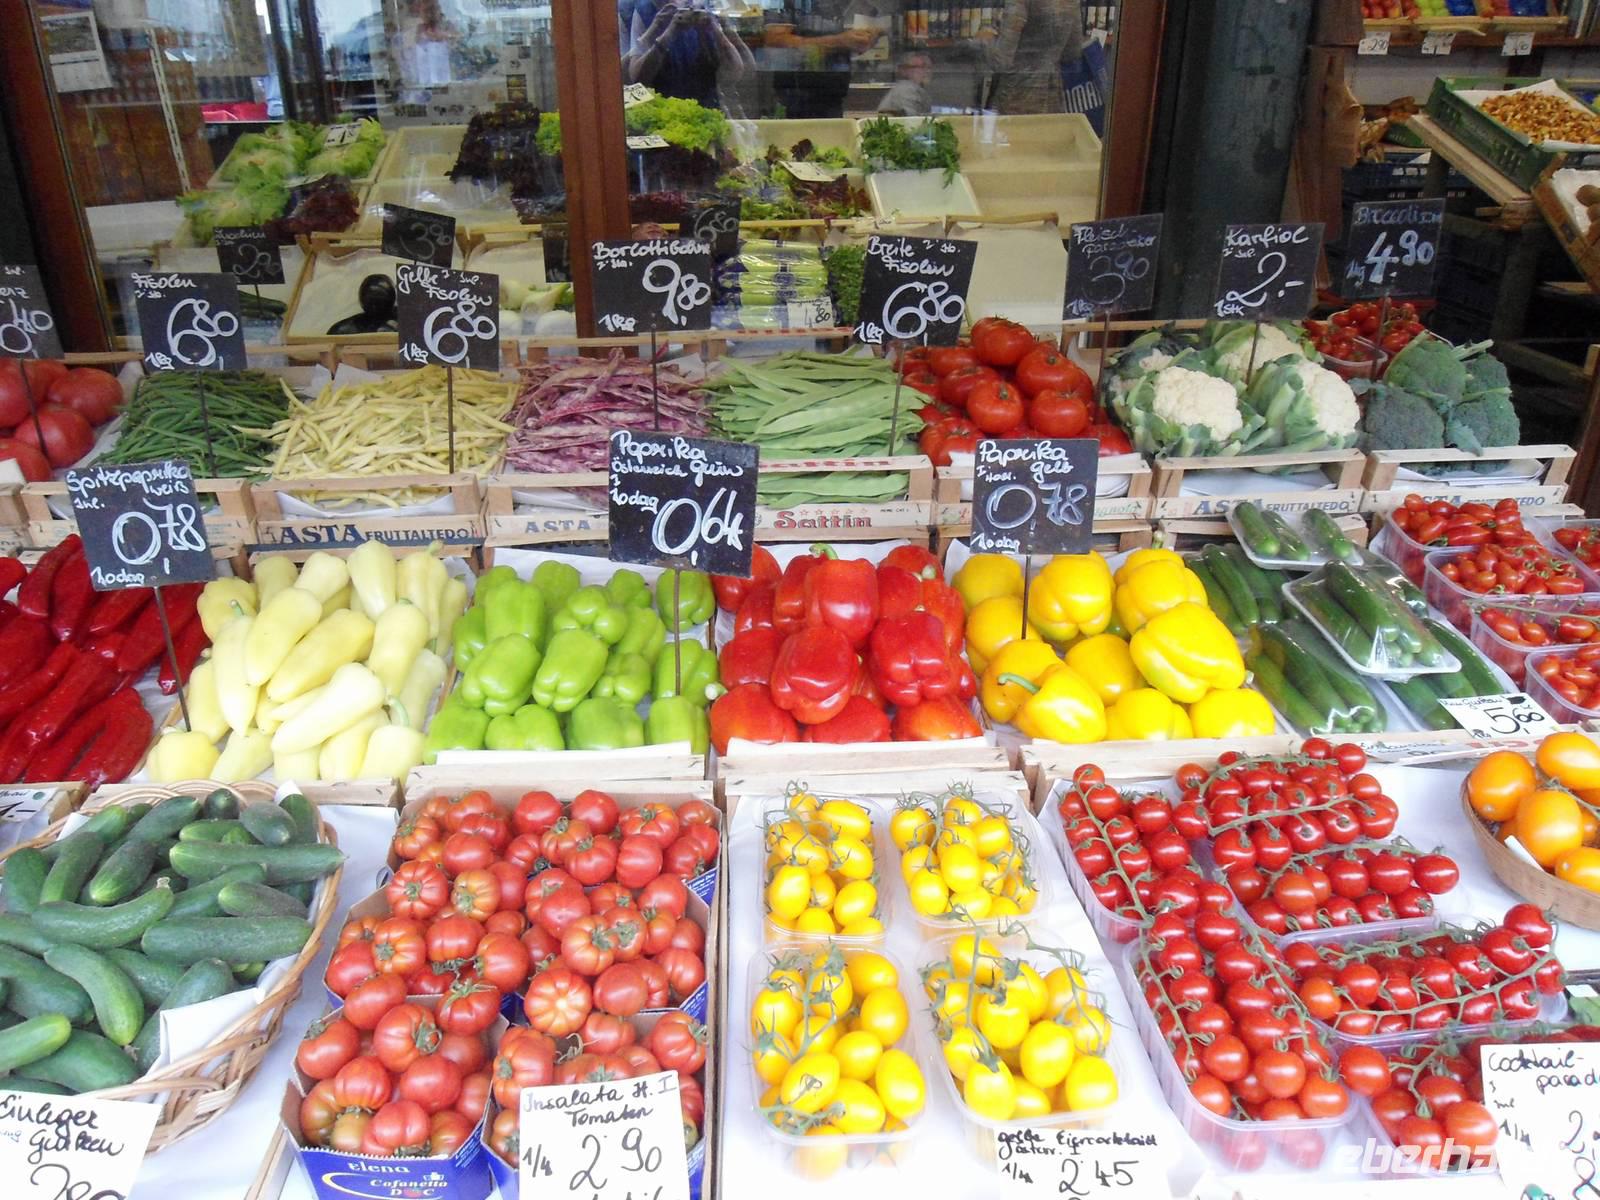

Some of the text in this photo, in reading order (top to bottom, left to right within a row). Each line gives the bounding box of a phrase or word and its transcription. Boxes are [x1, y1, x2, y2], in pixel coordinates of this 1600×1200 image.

[979, 440, 1069, 467] Paprika
[525, 519, 592, 533] ASTA
[774, 510, 873, 529] Sattin
[280, 523, 471, 546] ASTA FRUTTALTEDO
[522, 1084, 625, 1113] Insalata
[564, 1103, 654, 1128] Tomaten
[522, 1143, 553, 1178] 1/4
